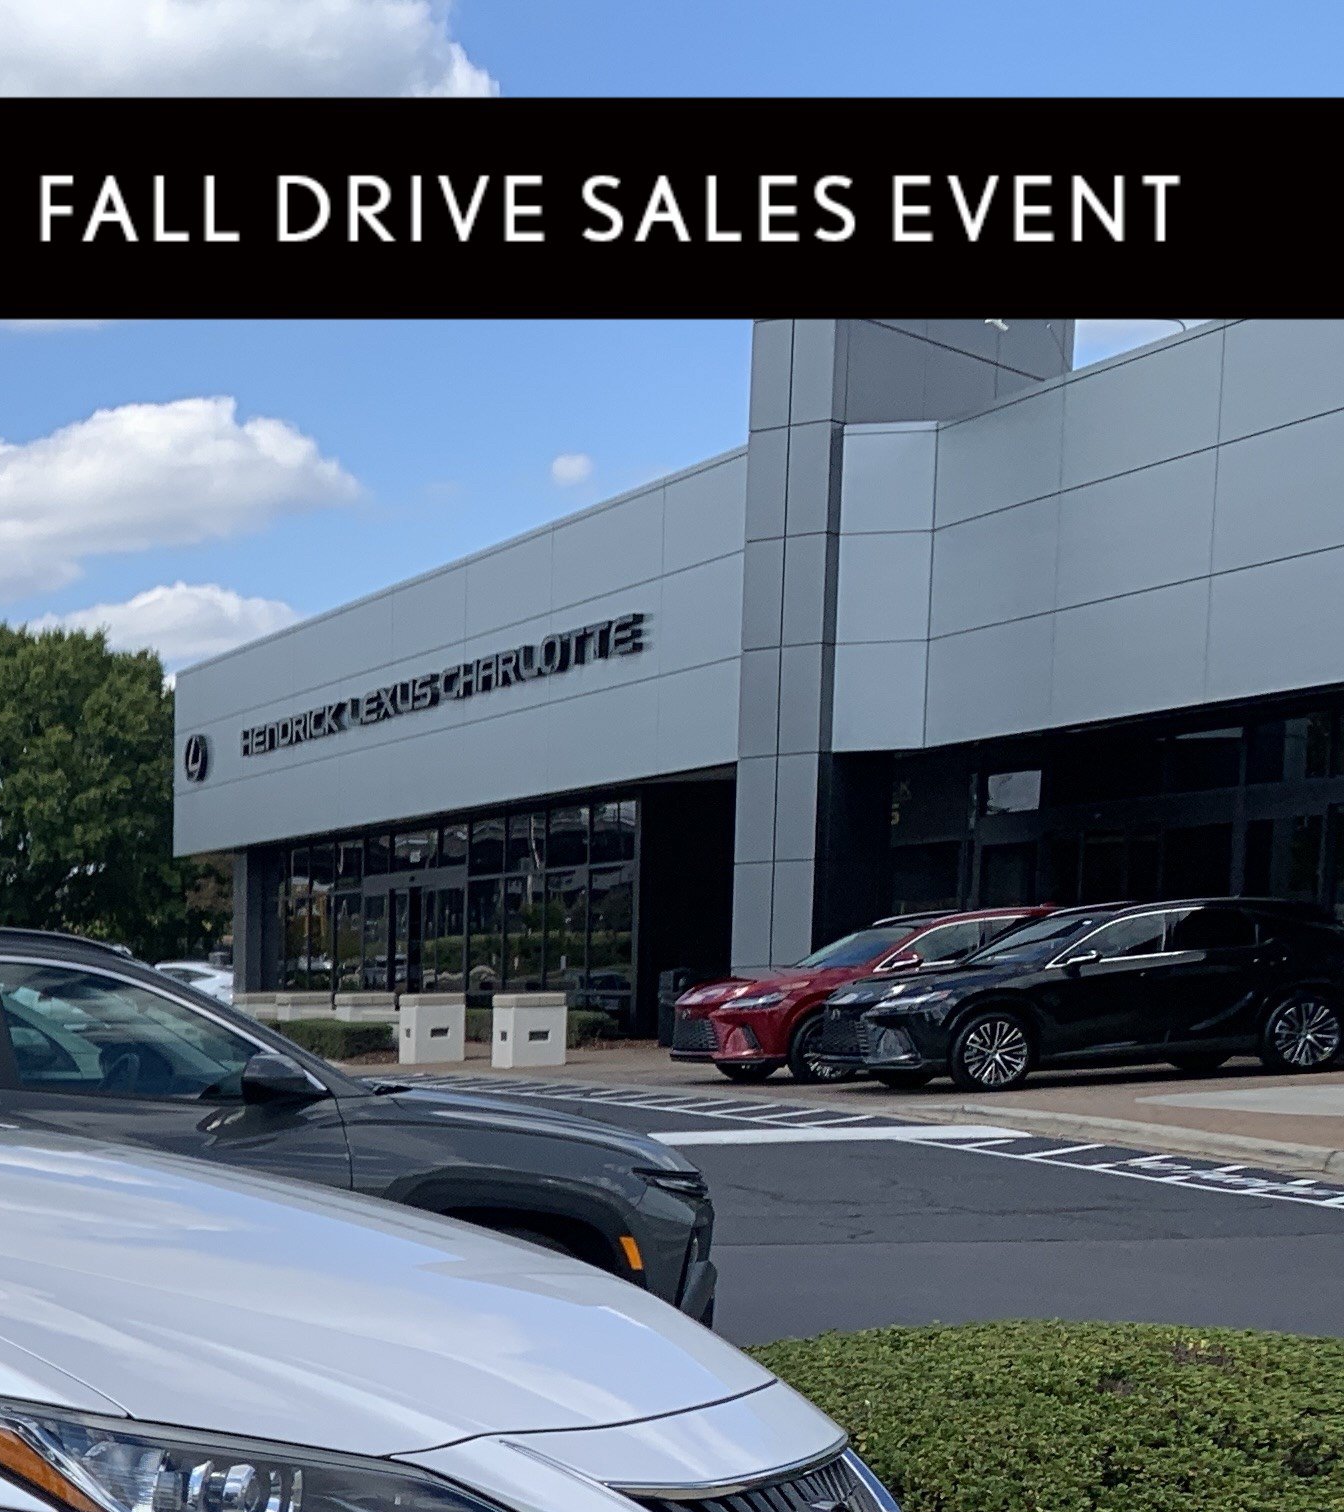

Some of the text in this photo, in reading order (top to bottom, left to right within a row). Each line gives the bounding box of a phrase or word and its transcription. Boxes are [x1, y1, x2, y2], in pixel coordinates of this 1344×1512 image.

[240, 612, 648, 757] HENDRICK LEXUS CHARLOTTE
